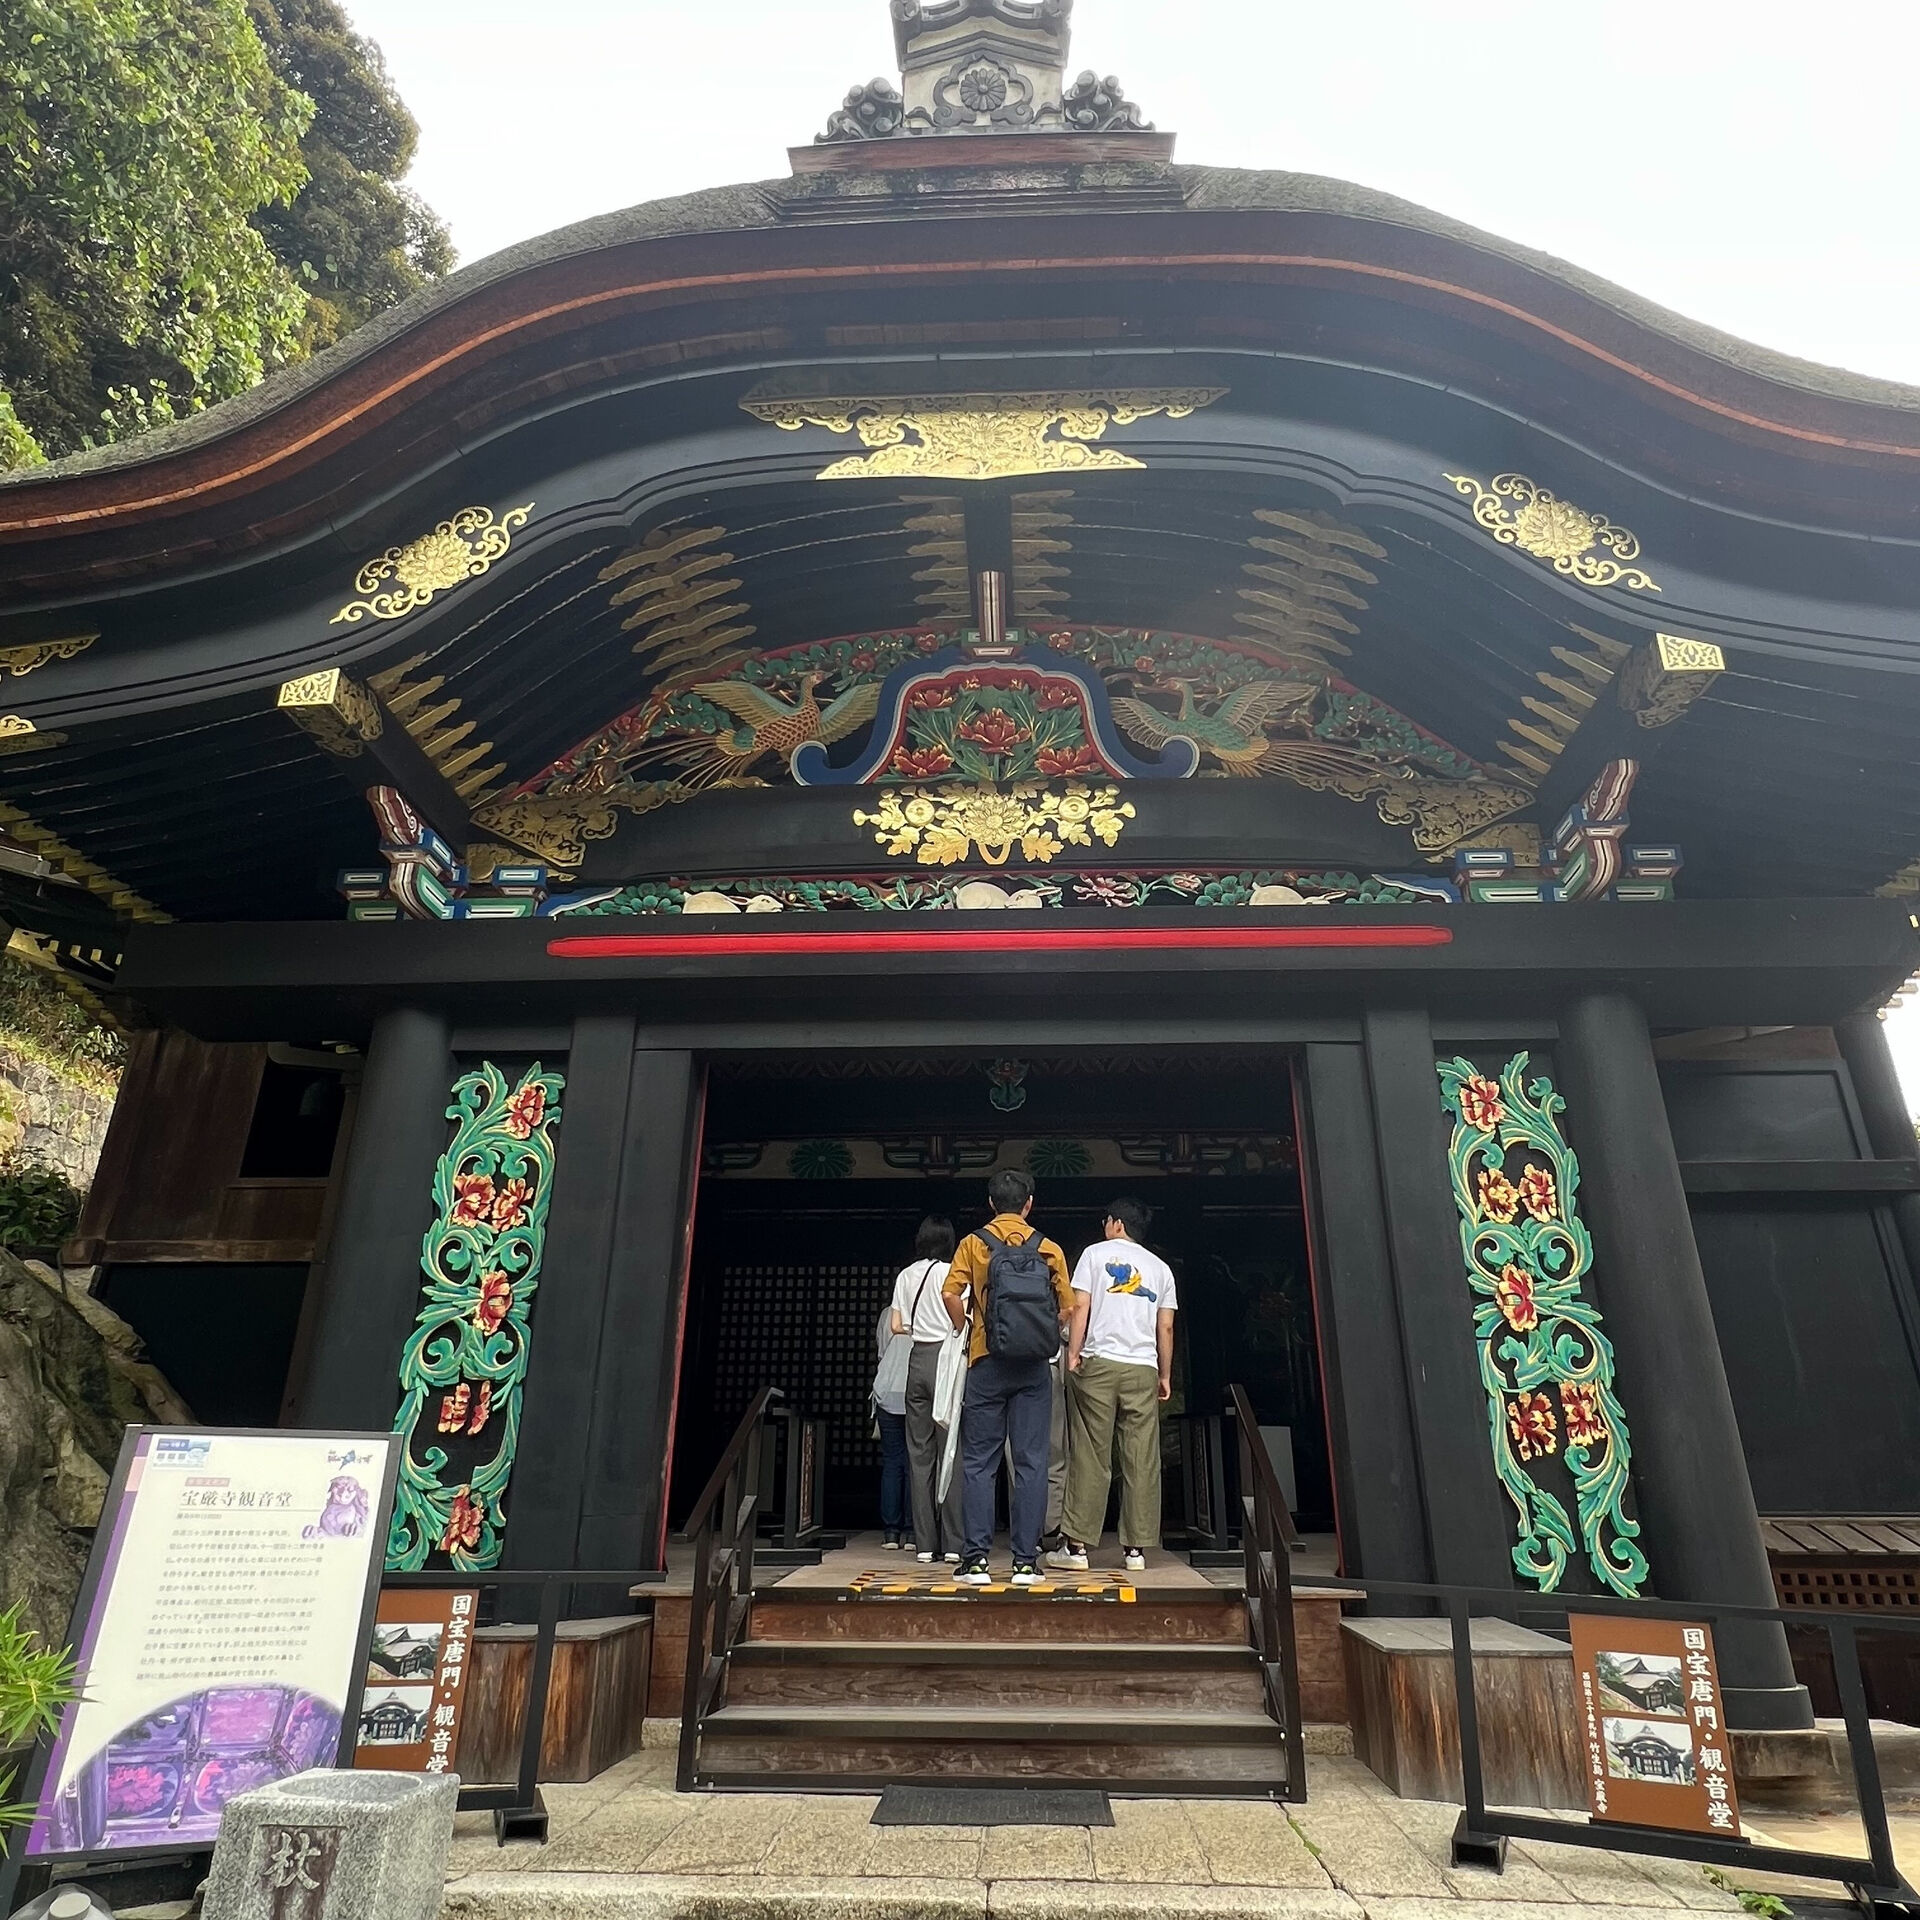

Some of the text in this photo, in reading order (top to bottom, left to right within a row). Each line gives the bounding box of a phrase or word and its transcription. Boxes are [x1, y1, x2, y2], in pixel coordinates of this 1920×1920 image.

[180, 1489, 294, 1508] 宝厳寺観音堂
[1682, 1627, 1734, 1829] 国宝唐門・観音堂
